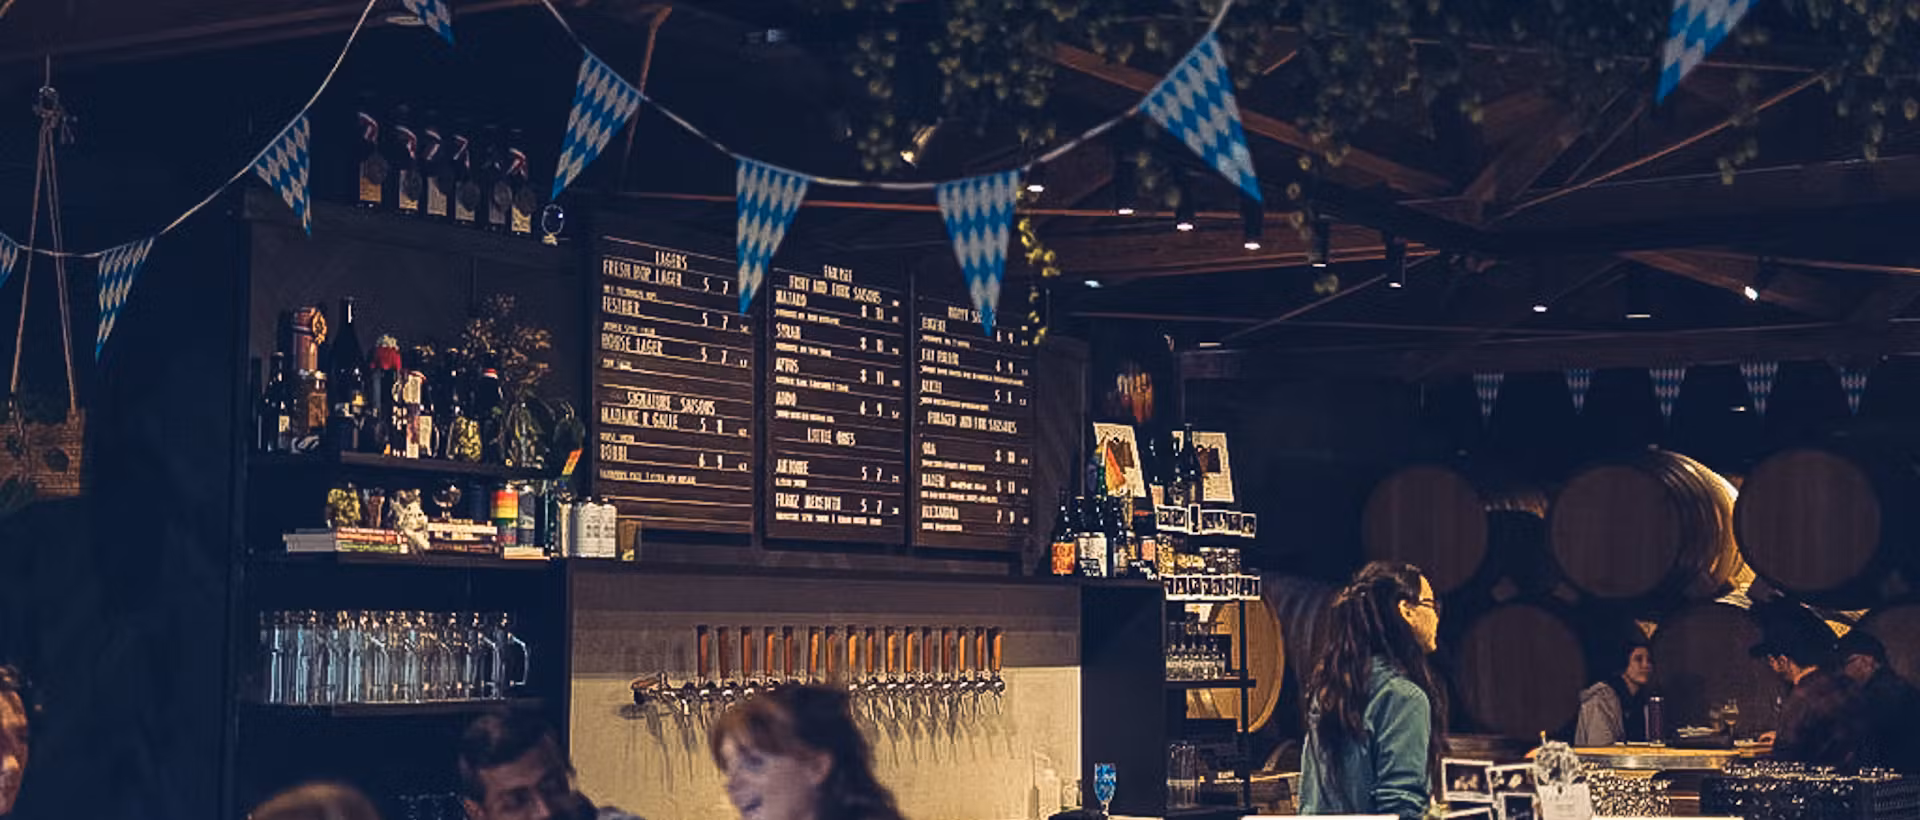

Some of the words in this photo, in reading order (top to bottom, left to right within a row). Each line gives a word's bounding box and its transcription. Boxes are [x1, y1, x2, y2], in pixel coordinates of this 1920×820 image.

[655, 251, 687, 271] LAGERS
[603, 259, 631, 280] FRESH
[655, 268, 682, 287] LAGER
[853, 286, 882, 304] SAISONS
[702, 312, 708, 327] 5
[722, 315, 729, 331] 7
[601, 333, 631, 352] HOUSE
[636, 338, 663, 356] LAGER
[995, 389, 1000, 402] 5
[862, 466, 868, 481] 5
[861, 498, 867, 513] 5
